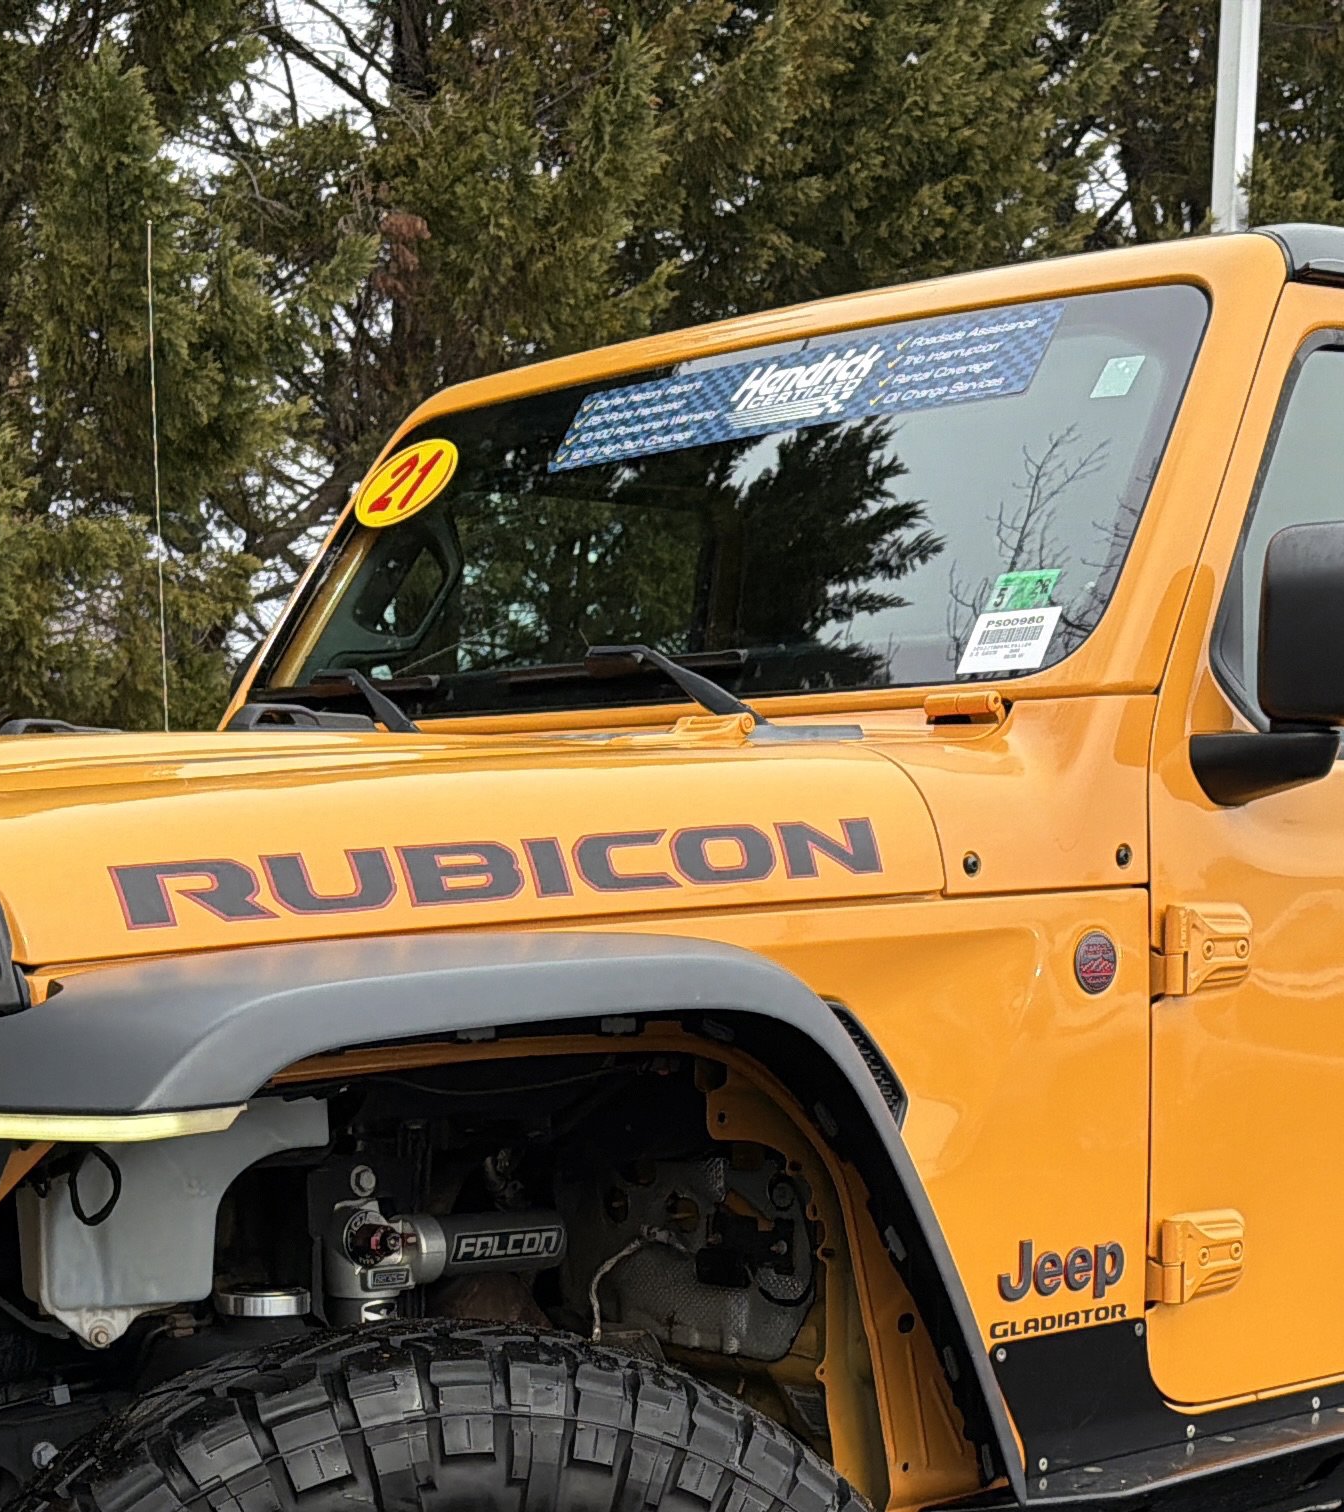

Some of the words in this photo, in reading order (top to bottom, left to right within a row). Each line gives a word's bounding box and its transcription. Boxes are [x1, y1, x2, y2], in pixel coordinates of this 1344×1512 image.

[910, 329, 966, 348] Roadside
[903, 354, 926, 368] Trip
[730, 344, 886, 412] Hendrick
[891, 369, 934, 385] Rental
[746, 377, 863, 410] CERTIFIED
[882, 391, 901, 404] Oil
[901, 385, 948, 401] Change
[367, 449, 445, 515] 21
[992, 586, 1009, 608] 5
[107, 817, 884, 930] RUBICON
[456, 1231, 559, 1260] FALCON
[997, 1239, 1125, 1302] Jeep
[989, 1303, 1128, 1340] GLADIATOR
